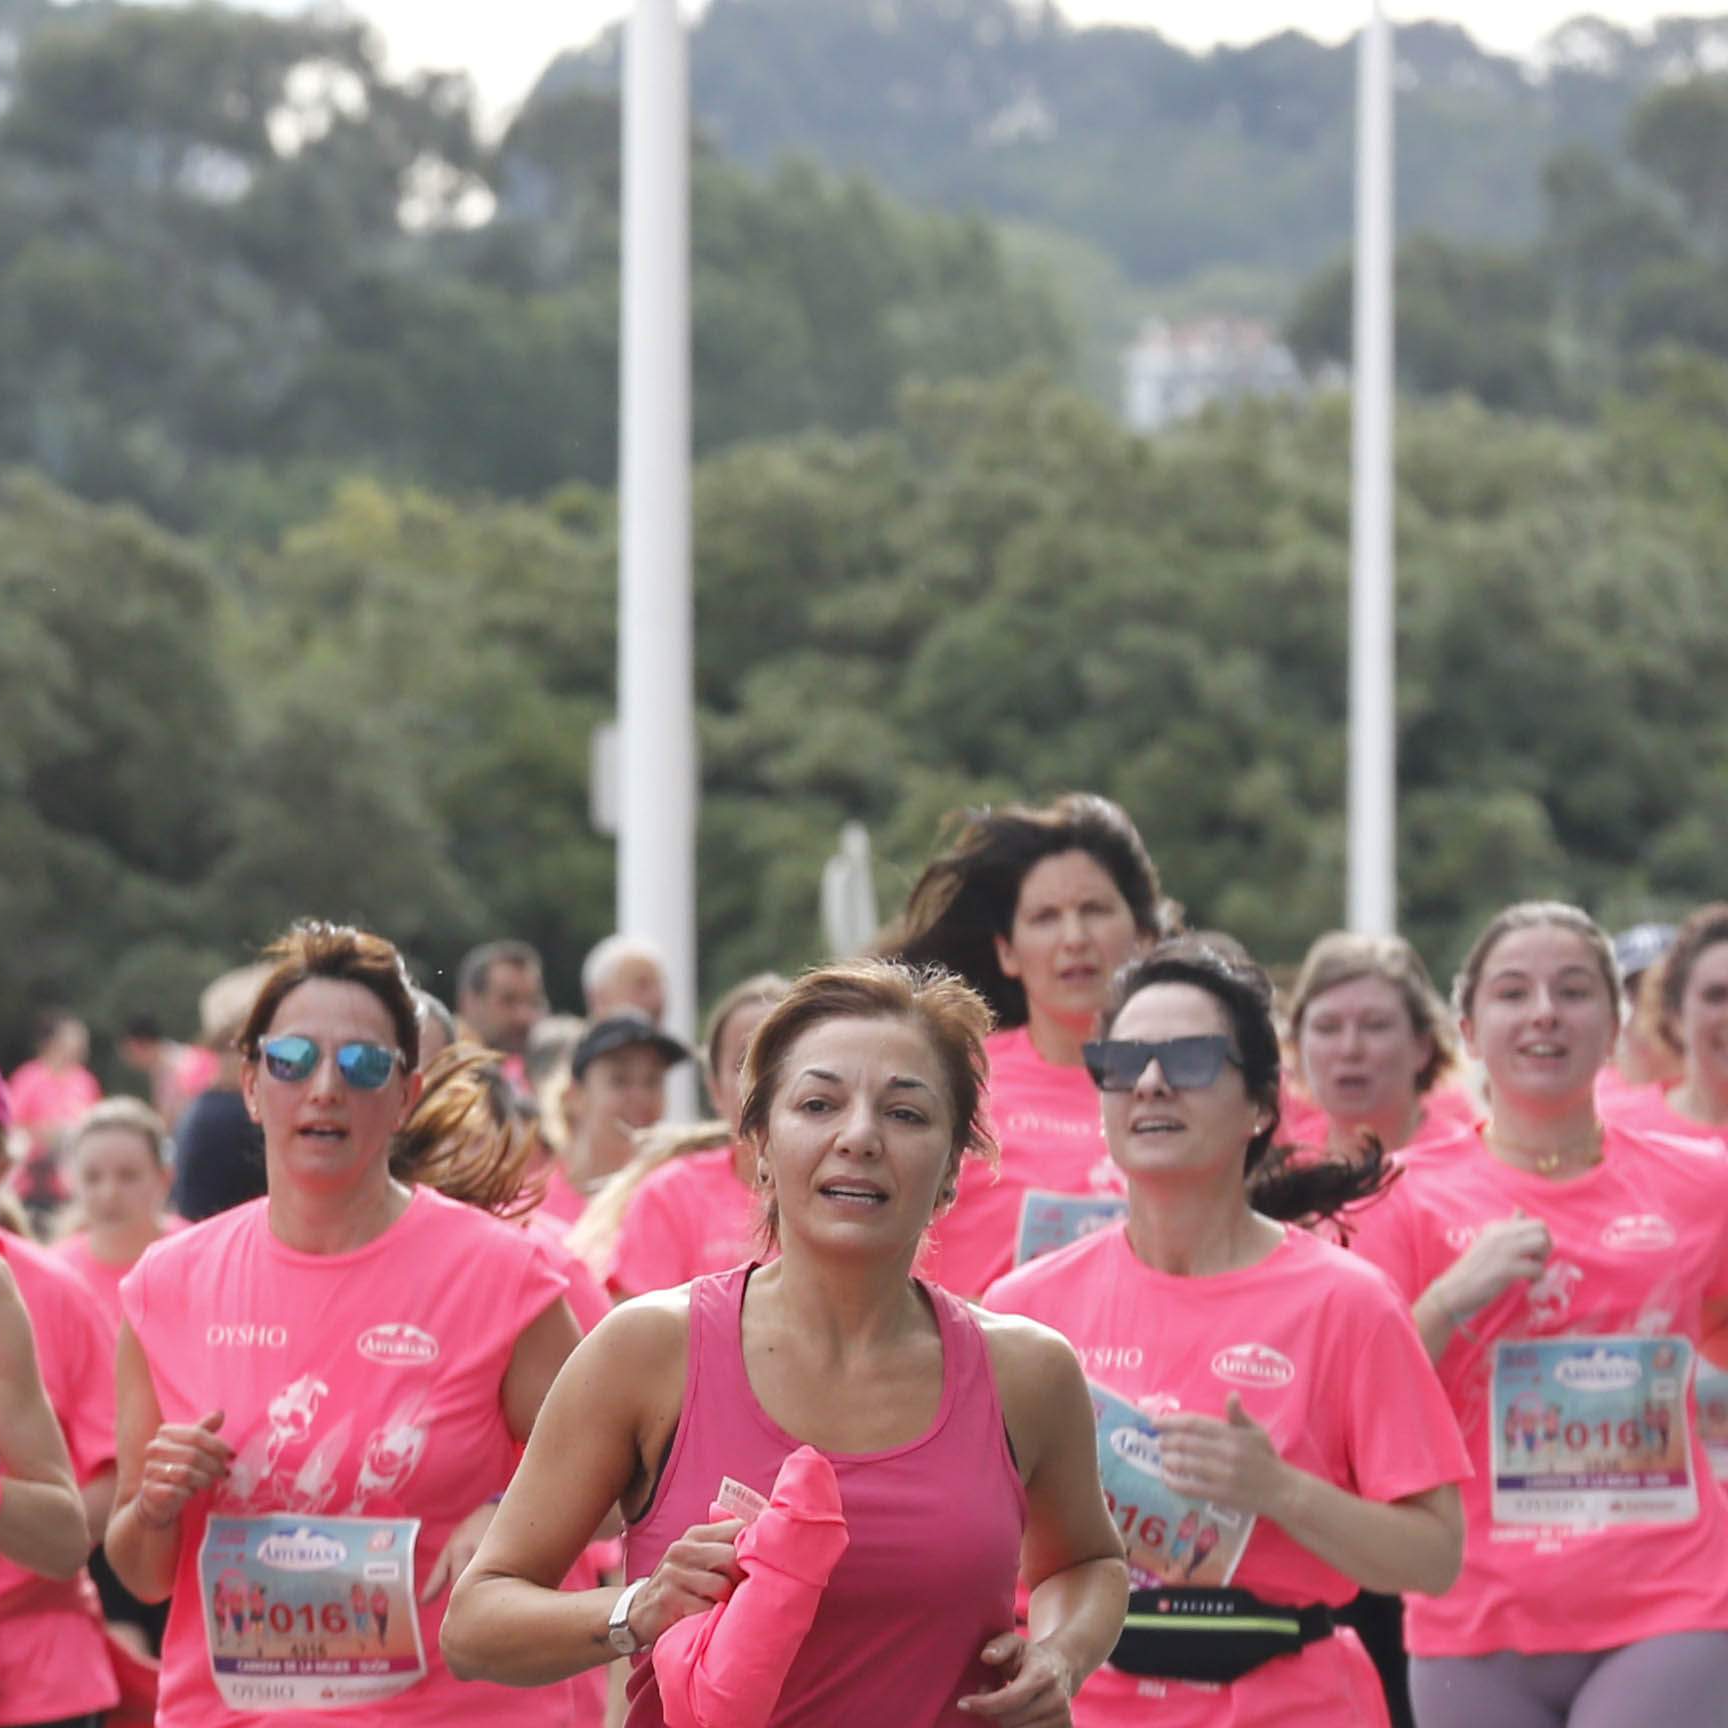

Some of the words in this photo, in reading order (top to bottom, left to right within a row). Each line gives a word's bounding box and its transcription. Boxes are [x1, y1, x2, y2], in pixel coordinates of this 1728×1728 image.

[206, 1324, 287, 1348] OYSHO
[1564, 1420, 1641, 1451] 016
[264, 1542, 342, 1562] ASTURIANA
[269, 1603, 348, 1634] 016
